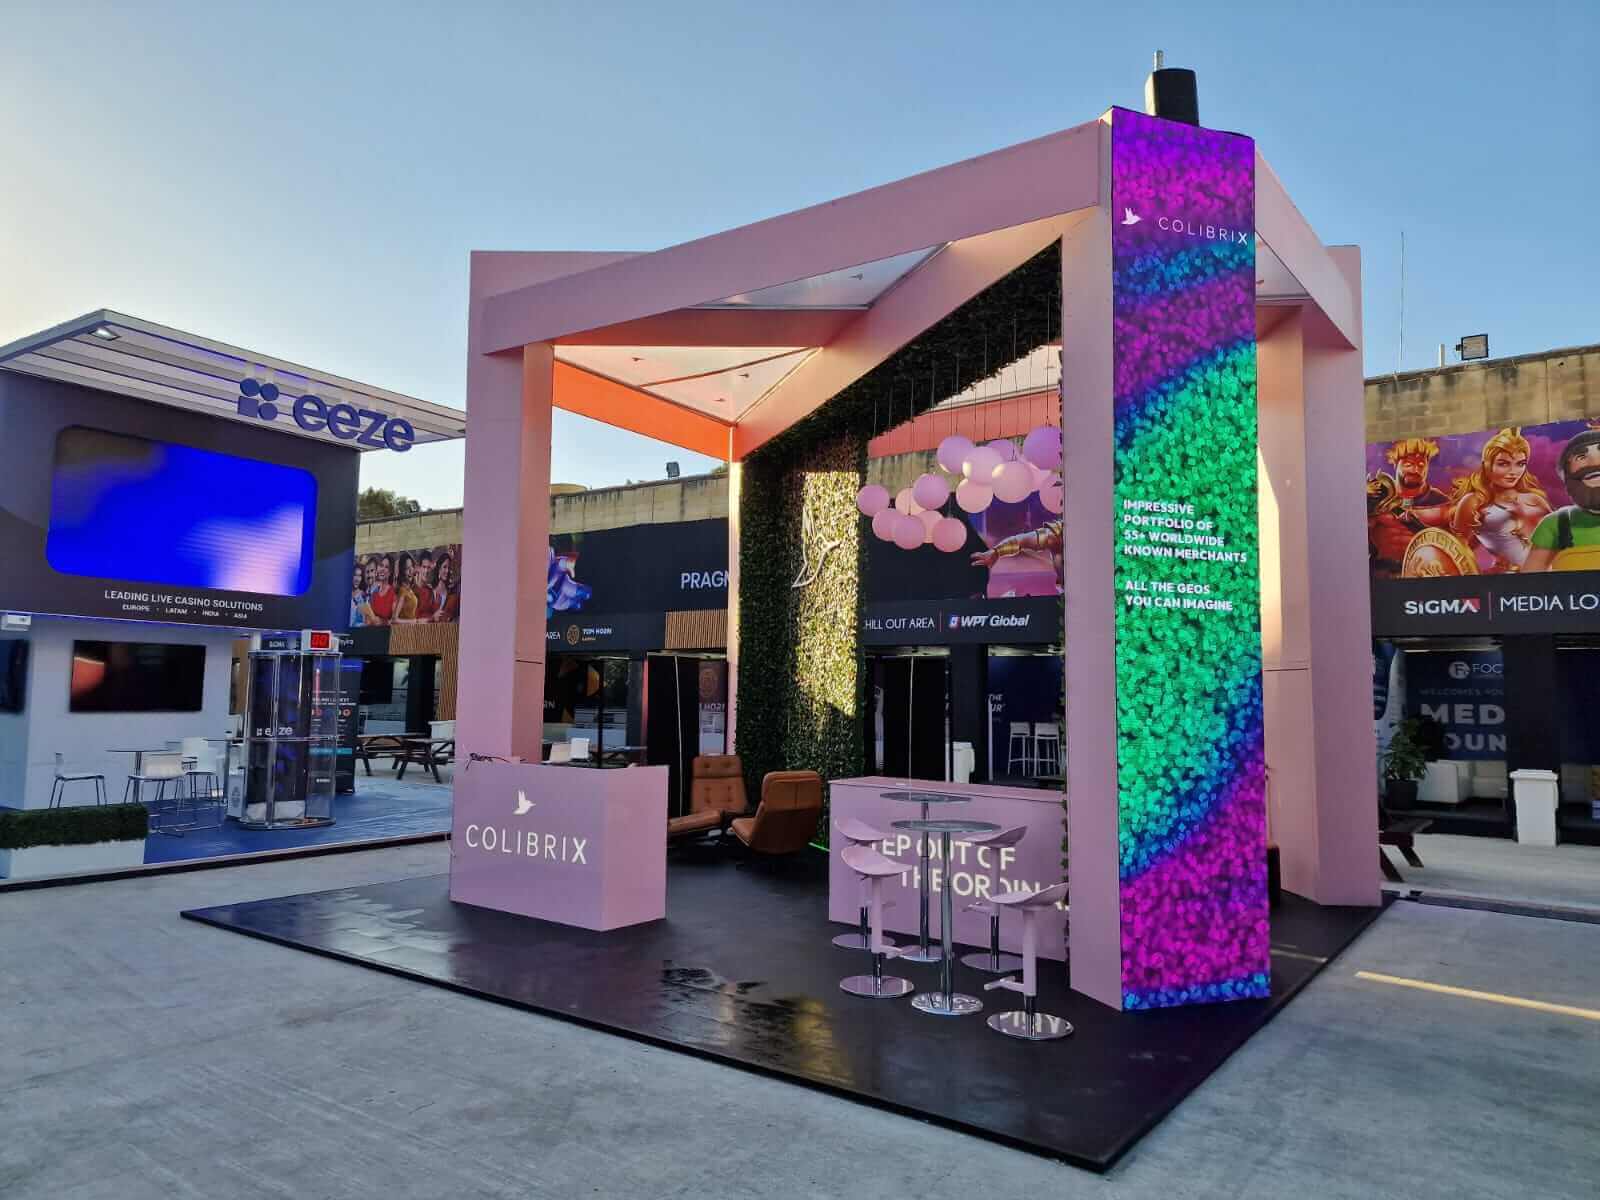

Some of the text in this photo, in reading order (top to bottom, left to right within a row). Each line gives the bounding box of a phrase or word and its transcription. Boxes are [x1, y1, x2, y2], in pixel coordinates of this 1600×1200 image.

[1158, 216, 1248, 246] COLIBRIX
[293, 394, 416, 452] eeze
[1123, 499, 1195, 515] IMPRESSIVE
[1124, 514, 1214, 531] PORTFOLIO OF
[1148, 531, 1225, 547] WORLDWIDE
[1124, 544, 1248, 563] KNOWN MERCHANTS
[681, 570, 729, 590] PRAG
[1125, 580, 1211, 595] ALL THE GEOS
[104, 590, 264, 612] LEADING LIVE CASINO SOLUTIONS
[122, 604, 150, 612] EUROPE
[1125, 595, 1233, 611] YOU CAN IMAGINE
[1500, 595, 1564, 613] MEDIA
[864, 617, 935, 630] HILL OUT AREA
[961, 613, 1030, 628] WPT Global
[264, 726, 293, 737] eze
[465, 824, 587, 865] COLIBRIX
